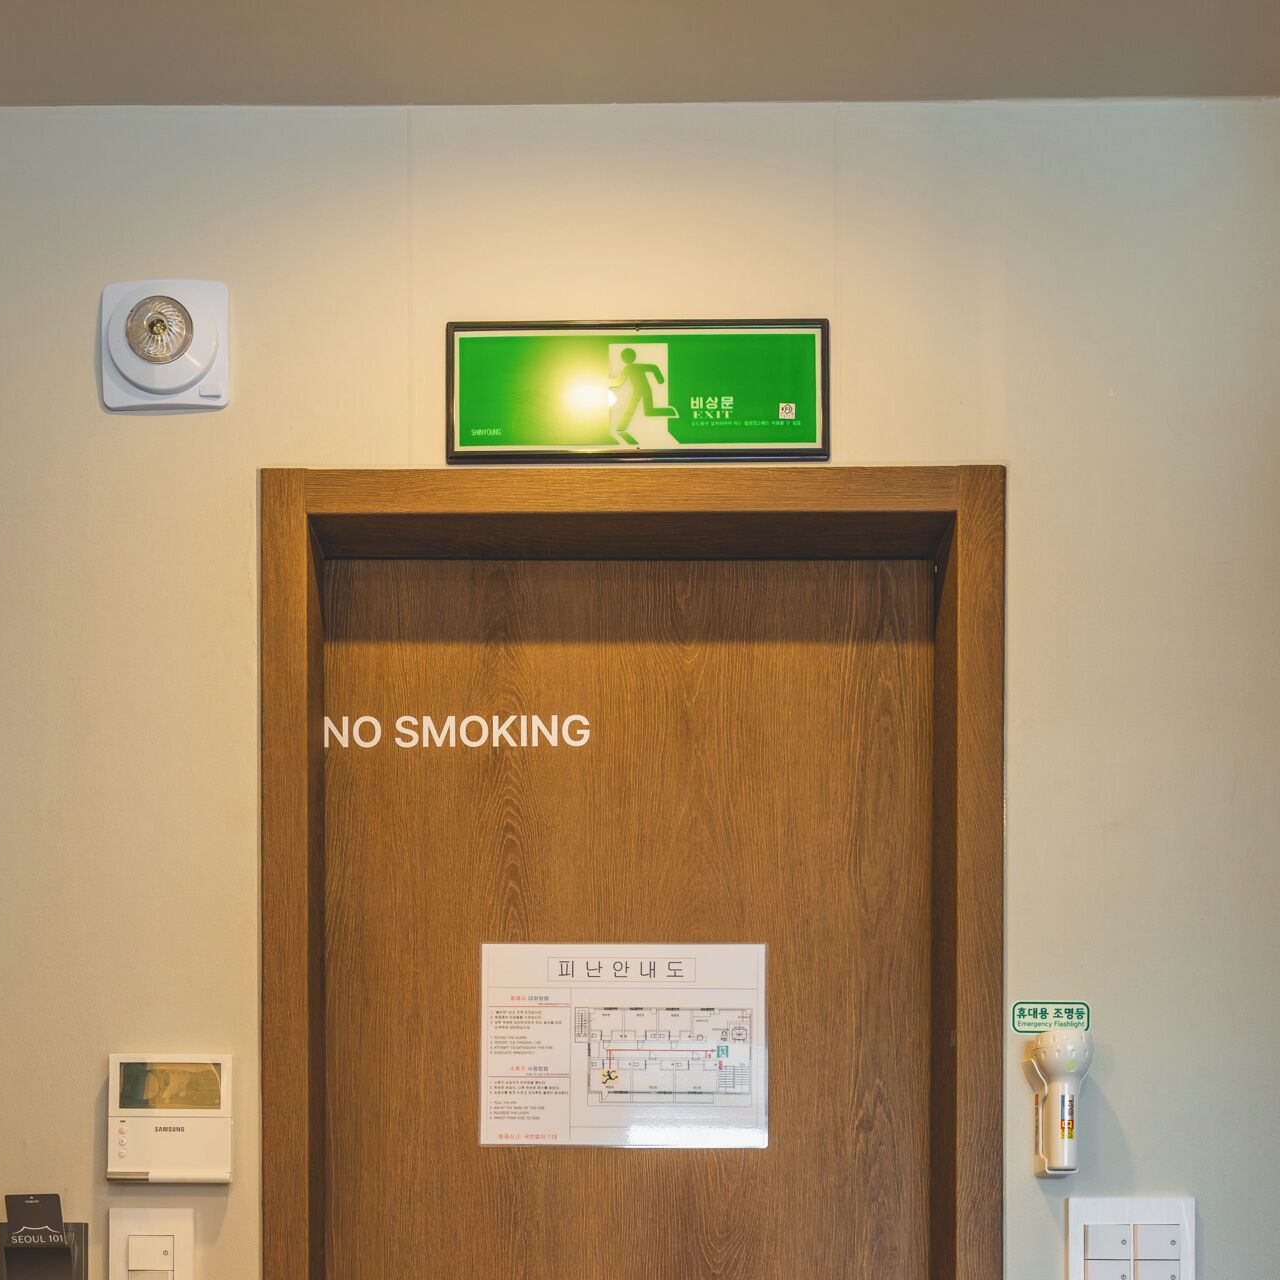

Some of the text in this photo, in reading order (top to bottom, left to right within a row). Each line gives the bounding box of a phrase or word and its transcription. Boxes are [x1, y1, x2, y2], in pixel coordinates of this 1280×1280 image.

[690, 396, 734, 409] 비상문
[693, 410, 733, 419] EXIT
[323, 714, 591, 748] NO SMOKING
[1017, 1007, 1086, 1020] 휴대용 조명등
[11, 1234, 64, 1244] SEOUL 101
